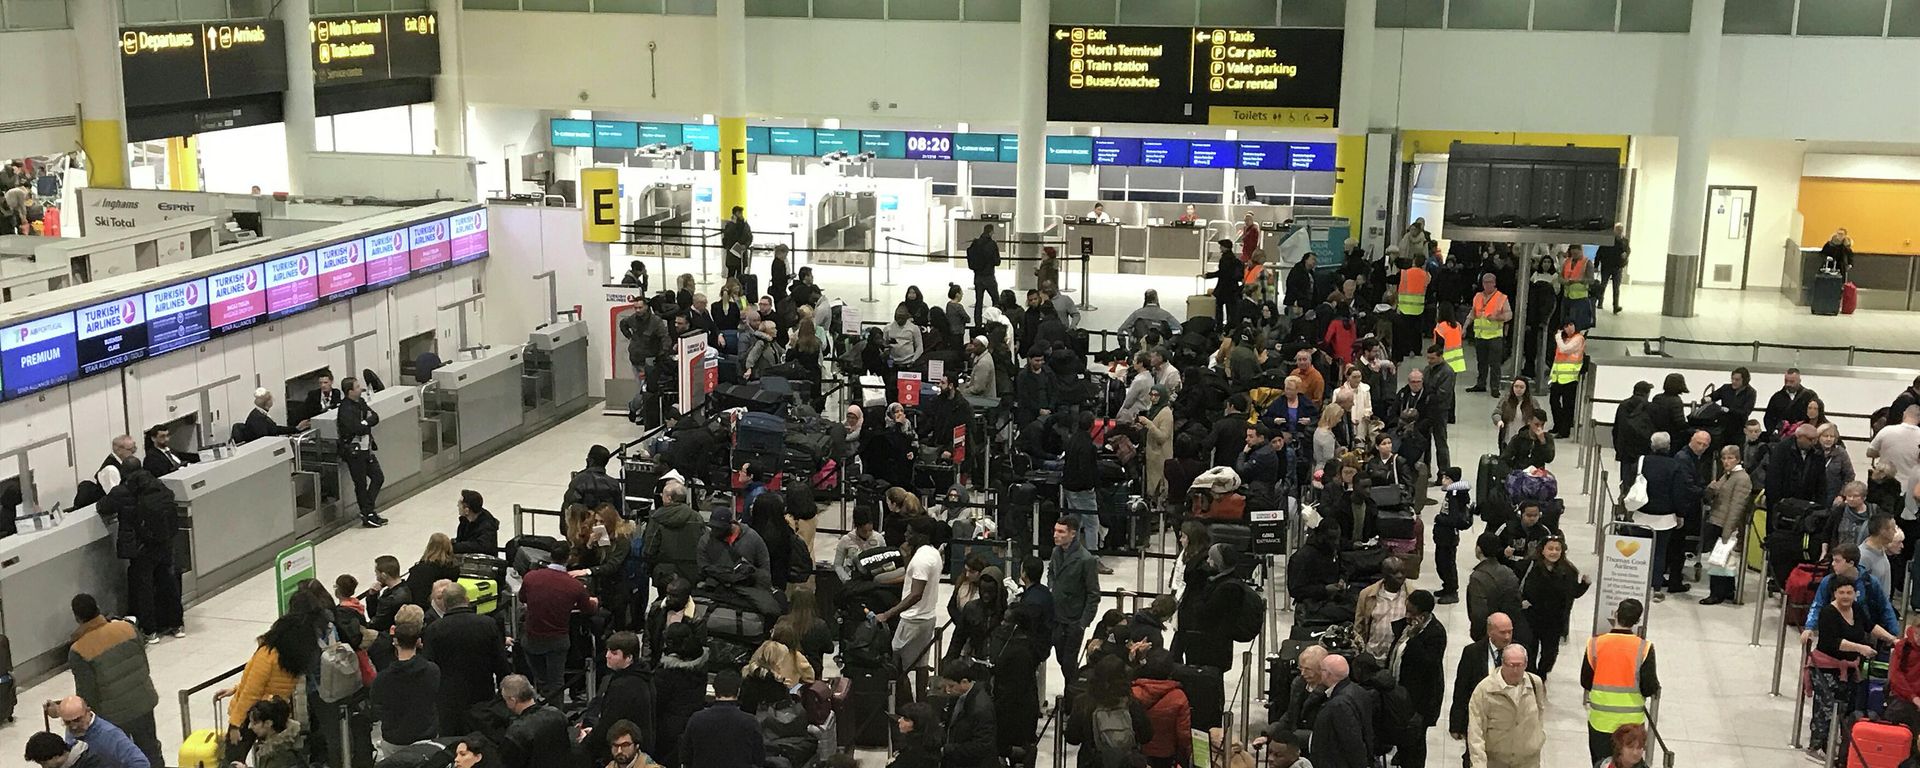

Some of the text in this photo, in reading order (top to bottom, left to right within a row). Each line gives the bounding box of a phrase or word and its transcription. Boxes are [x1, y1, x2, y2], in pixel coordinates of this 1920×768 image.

[329, 18, 381, 36] North Terminal
[405, 16, 418, 32] Exit
[233, 24, 266, 42] Arrivals
[1087, 29, 1107, 40] Exit
[1229, 30, 1256, 42] Taxis
[139, 32, 194, 52] Departures
[330, 42, 375, 58] Train station
[1086, 44, 1162, 56] North Terminal
[1227, 46, 1246, 58] Car
[1247, 47, 1277, 60] parks
[1086, 60, 1149, 72] Train station
[1226, 62, 1254, 74] Valet
[1255, 62, 1297, 77] parking
[1086, 75, 1160, 88] Buses/coaches
[1226, 78, 1278, 90] Car rental
[1233, 110, 1268, 121] Toilets
[908, 136, 950, 152] 08:20
[731, 148, 744, 175] F
[102, 198, 140, 210] Inghams
[593, 188, 615, 225] E
[95, 216, 136, 228] Ski Total
[455, 216, 474, 226] TURKISH
[414, 225, 436, 236] TURKISH
[456, 223, 474, 234] AIRLINES
[371, 235, 392, 246] TURKISH
[415, 234, 436, 246] AIRLINES
[323, 246, 347, 259] TURKISH
[372, 244, 394, 256] AIRLINES
[272, 260, 298, 272] TURKISH
[324, 256, 348, 269] AIRLINES
[216, 272, 244, 288] TURKISH
[273, 269, 298, 282] AIRLINES
[154, 288, 184, 303] TURKISH
[216, 283, 245, 298] AIRLINES
[155, 298, 185, 314] AIRLINES
[85, 304, 120, 322] TURKISH
[86, 316, 121, 334] AIRLINES
[21, 347, 60, 368] PREMIUM
[85, 366, 98, 374] STAR
[98, 356, 122, 370] ALLIANCE
[1606, 556, 1630, 564] Thomas
